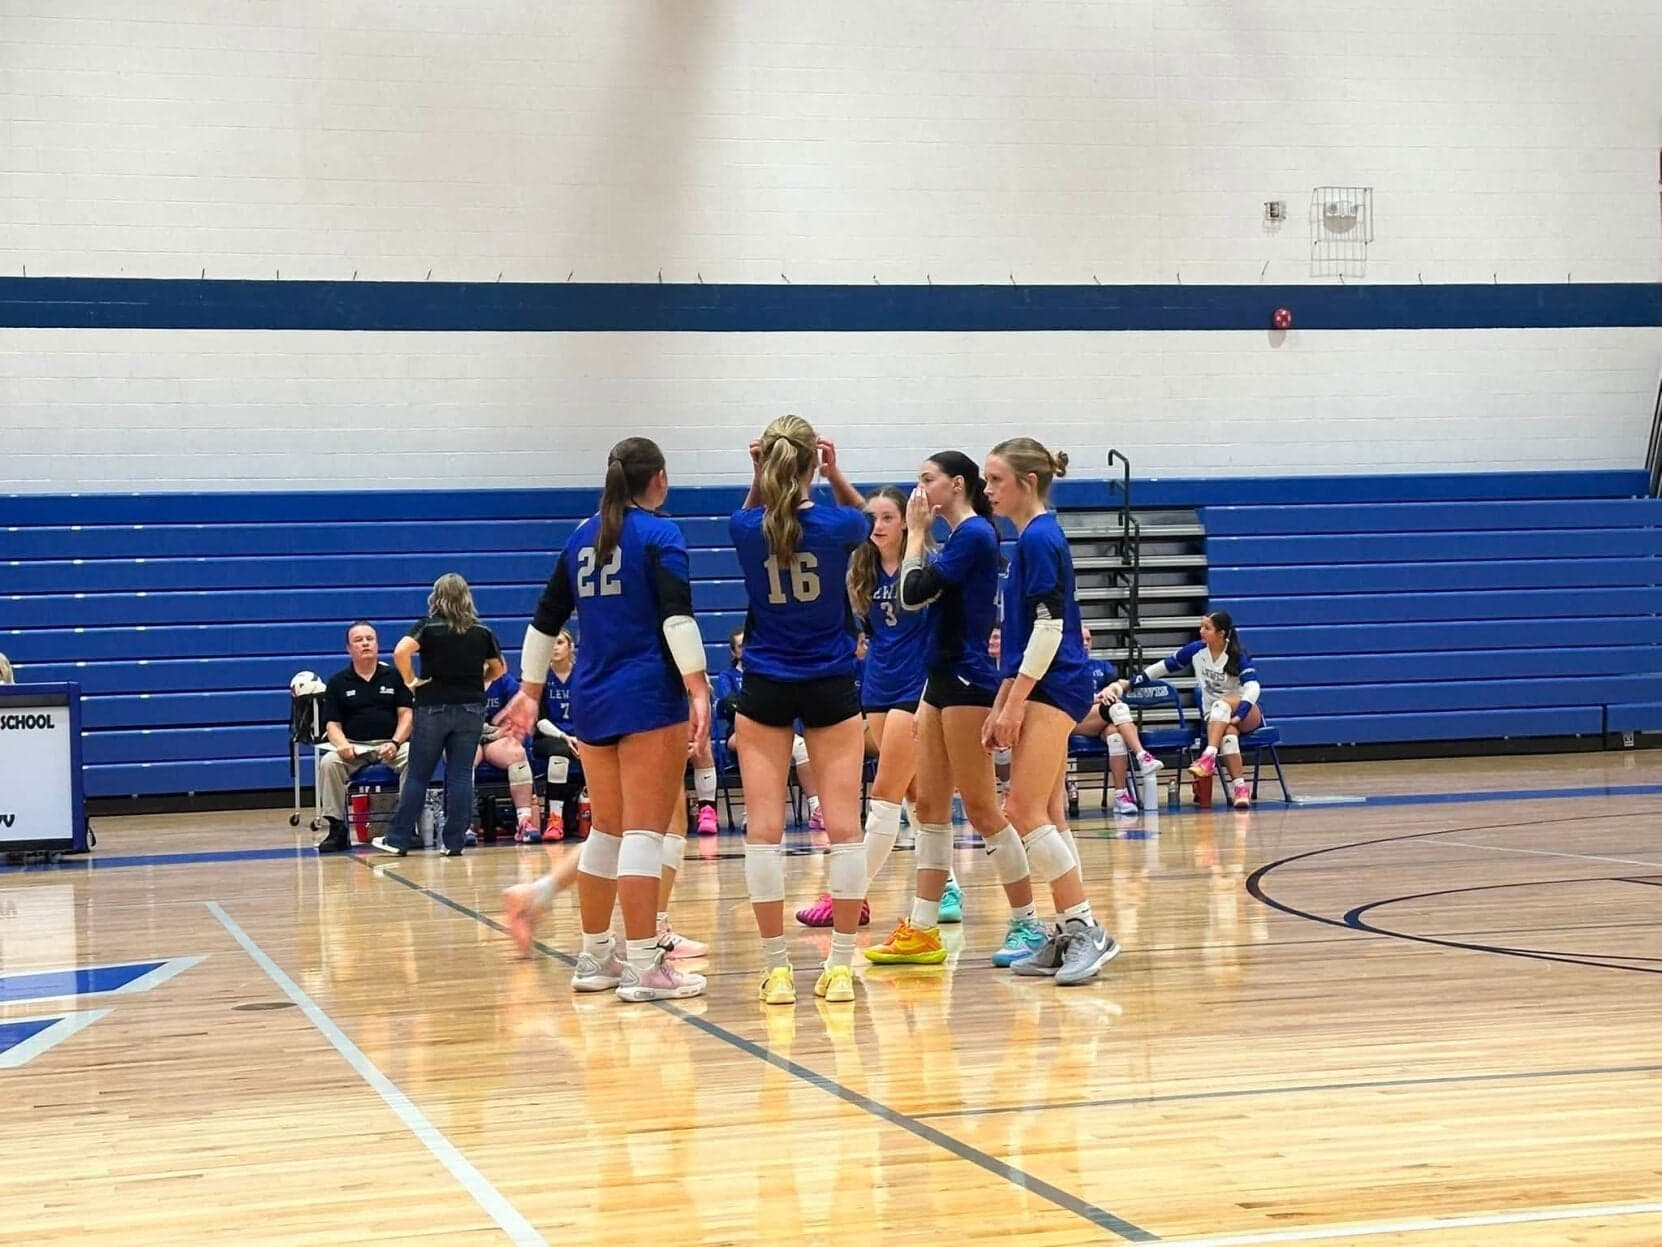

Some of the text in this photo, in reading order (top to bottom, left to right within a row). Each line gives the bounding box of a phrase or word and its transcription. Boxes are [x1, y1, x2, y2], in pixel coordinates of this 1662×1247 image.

[577, 545, 623, 598] 22
[763, 551, 821, 605] 16
[880, 601, 898, 626] 3
[0, 714, 55, 730] SCHOOL
[560, 702, 570, 719] 7
